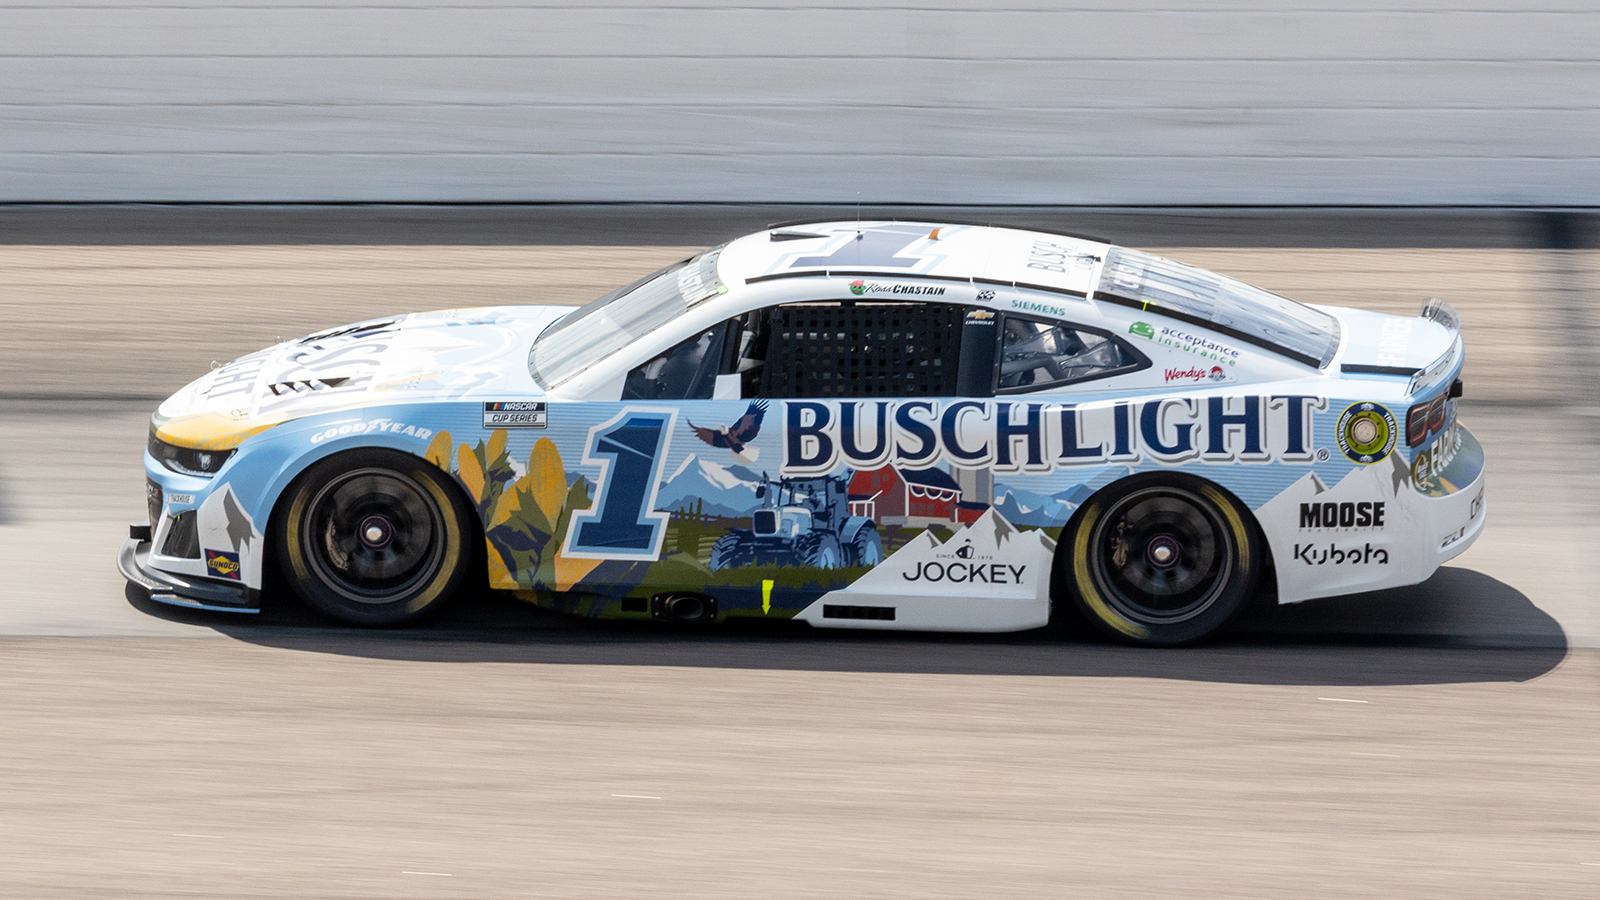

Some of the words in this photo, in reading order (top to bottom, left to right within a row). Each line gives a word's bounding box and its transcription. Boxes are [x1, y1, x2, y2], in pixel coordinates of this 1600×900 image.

[892, 284, 947, 296] CHASTAIN
[1011, 300, 1066, 316] SIEMENS
[1158, 334, 1237, 367] insurance
[1161, 326, 1240, 358] acceptance
[1164, 366, 1206, 382] Wendy's
[504, 402, 538, 411] NASCAR
[492, 414, 509, 422] CUP
[510, 414, 538, 422] SERIES
[310, 418, 433, 444] GOODYEAR
[564, 408, 678, 561] 1
[1300, 502, 1385, 528] MOOSE
[209, 559, 239, 570] SUNOCO
[1294, 543, 1389, 565] Kubota
[902, 561, 1026, 584] JOCKEY
